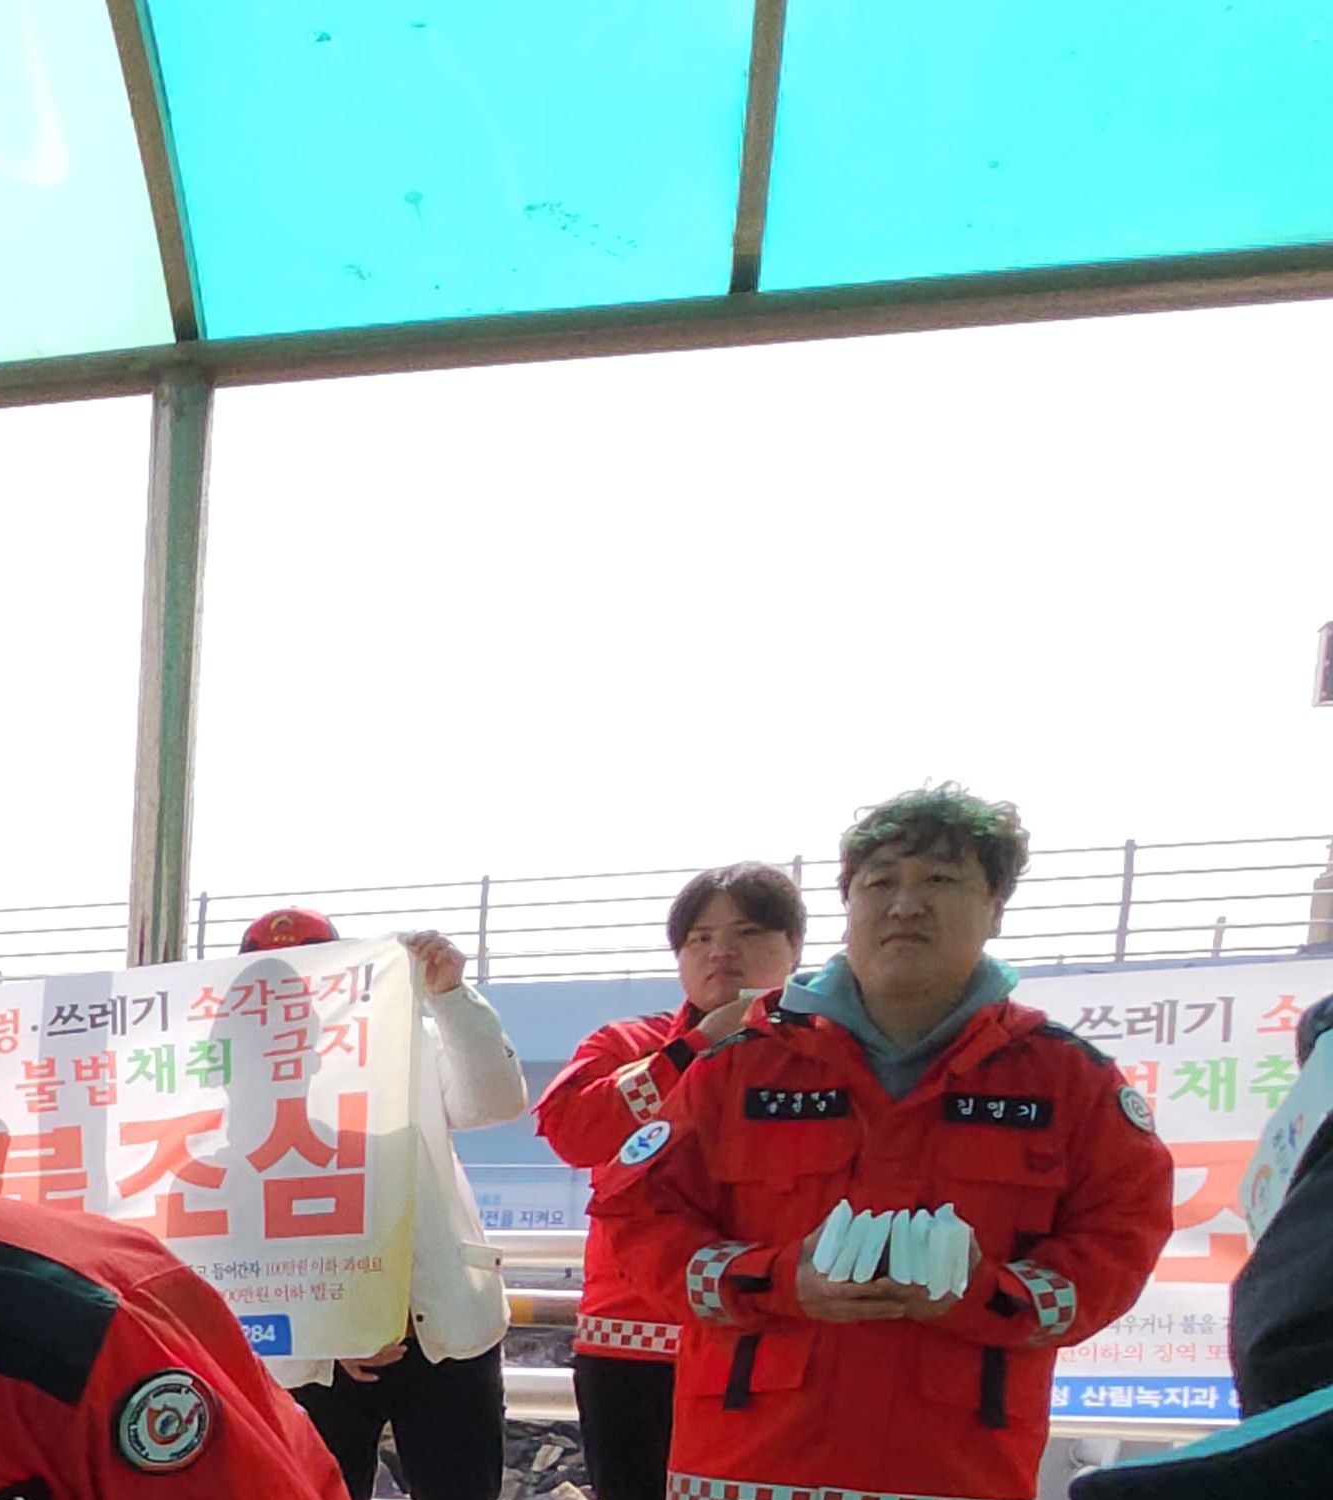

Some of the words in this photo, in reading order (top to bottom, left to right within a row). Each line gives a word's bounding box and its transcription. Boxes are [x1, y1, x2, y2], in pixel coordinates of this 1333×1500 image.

[186, 963, 374, 1027] 소각금지!
[263, 1017, 368, 1083] 금지
[1154, 1343, 1197, 1363] 징역
[1080, 1385, 1219, 1409] 산림녹지과
